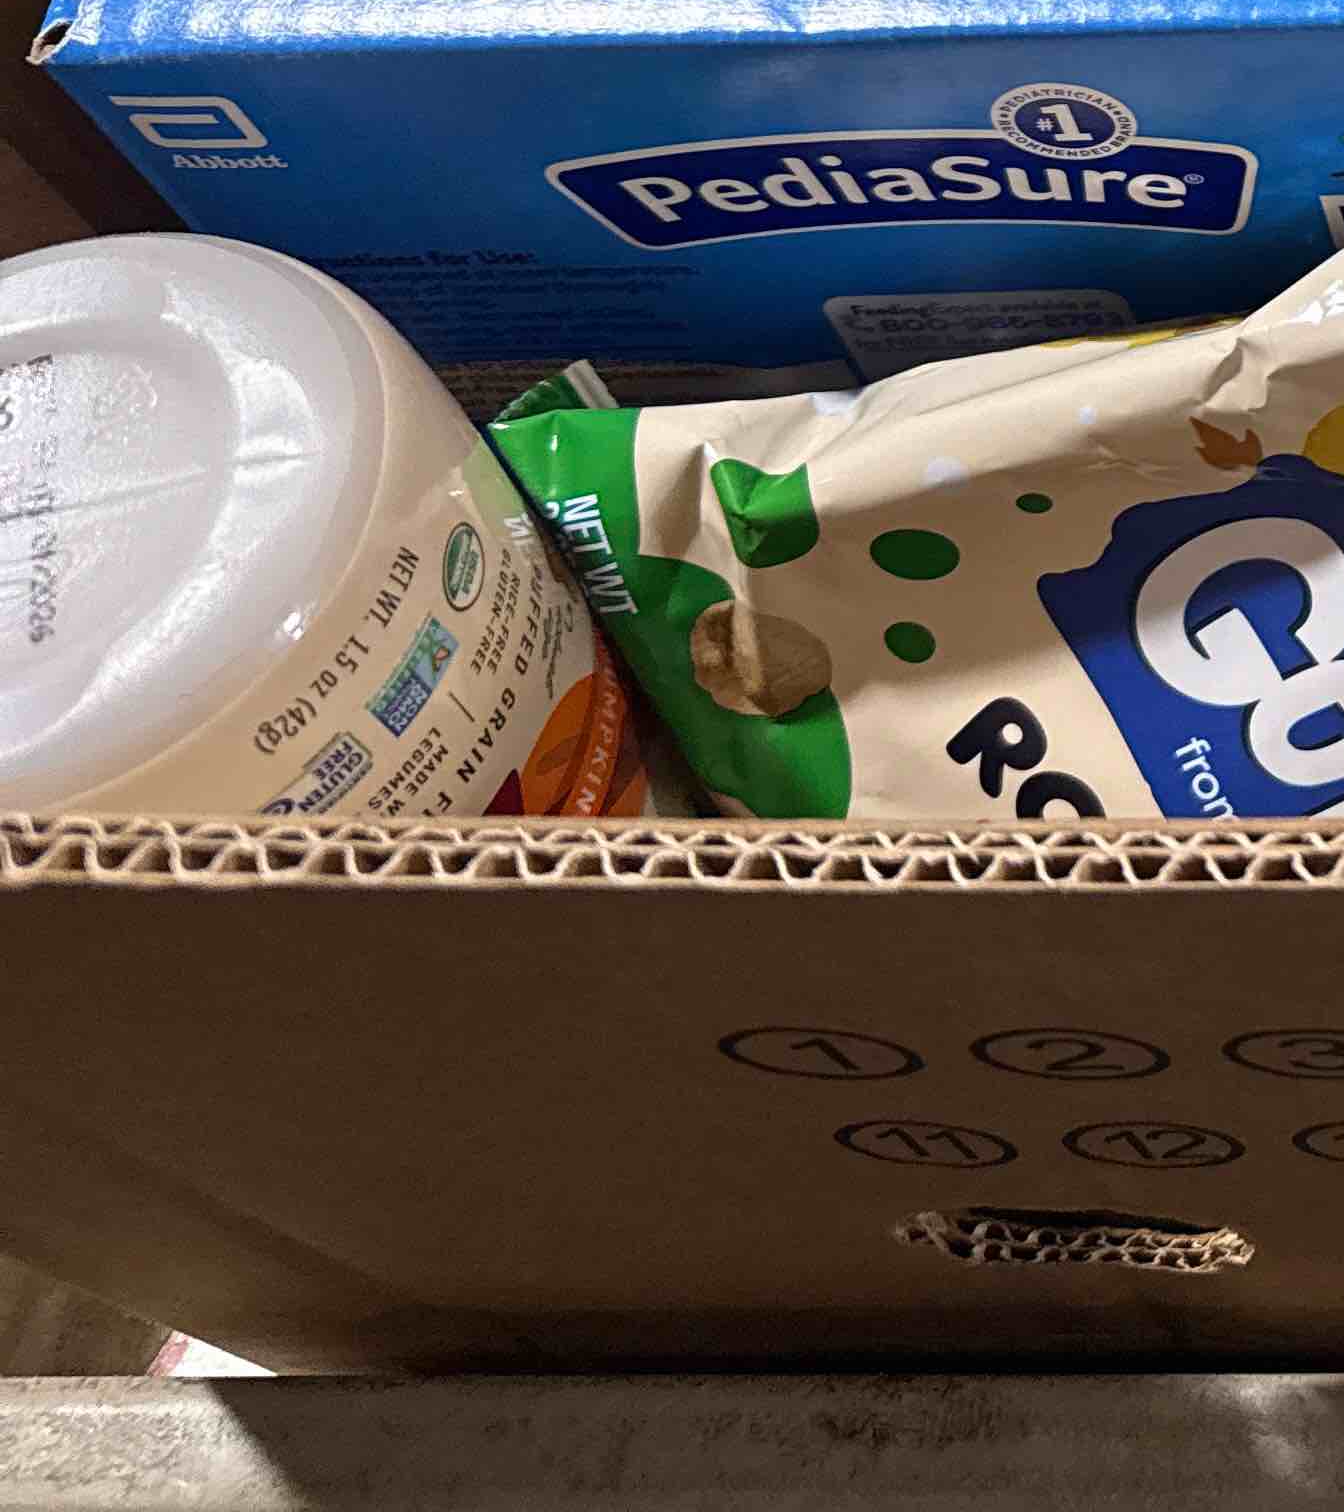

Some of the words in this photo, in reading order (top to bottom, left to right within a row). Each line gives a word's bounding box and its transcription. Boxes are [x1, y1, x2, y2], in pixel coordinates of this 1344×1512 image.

[172, 152, 288, 172] Abbott
[560, 491, 612, 555] NET
[389, 545, 419, 592] NET
[583, 561, 640, 615] WT
[363, 585, 402, 629] WT.
[487, 571, 520, 676] RICE-FREE
[336, 635, 369, 674] 1.5
[311, 669, 339, 699] oz
[255, 697, 318, 755] (42g)
[457, 688, 517, 783] GRAIN
[298, 751, 362, 812] GLUTEN
[314, 739, 353, 780] FREE
[367, 727, 441, 809] LEGUMES
[878, 1124, 976, 1160] 11
[1104, 1123, 1210, 1160] 12
